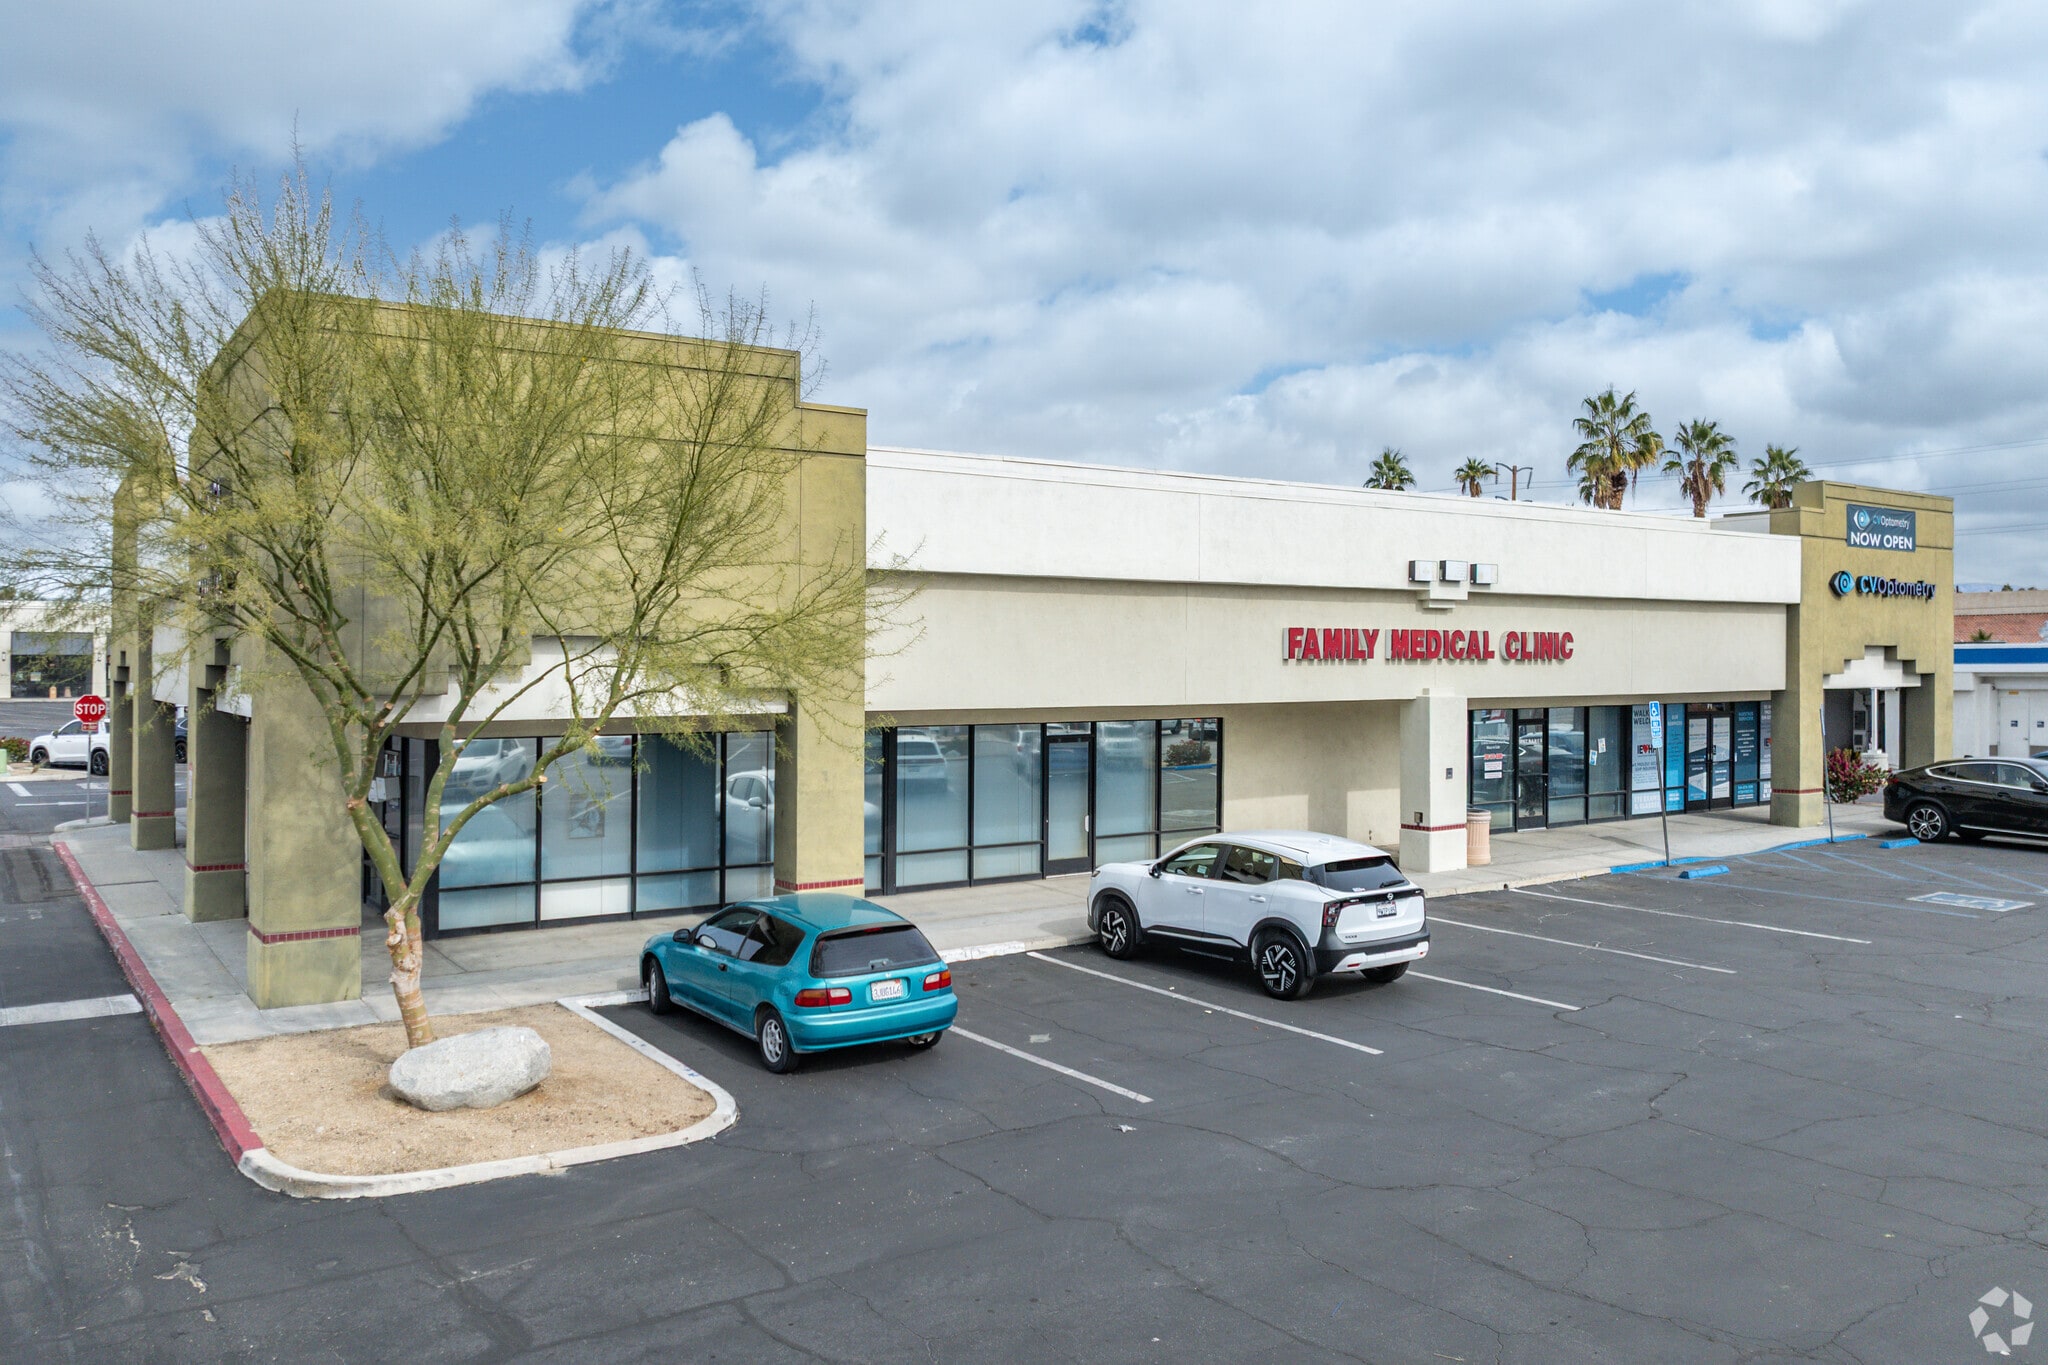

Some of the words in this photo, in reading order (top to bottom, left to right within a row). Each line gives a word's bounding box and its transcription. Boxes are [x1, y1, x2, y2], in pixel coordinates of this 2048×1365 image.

[1872, 514, 1910, 530] CVOptometry
[1850, 532, 1881, 547] NOW
[1883, 534, 1913, 550] OPEN
[1856, 574, 1936, 602] CVOptometry
[1282, 627, 1380, 660] FAMILY
[1385, 628, 1495, 660] MEDICAL
[1501, 630, 1574, 660] CLINIC
[76, 703, 106, 715] STOP
